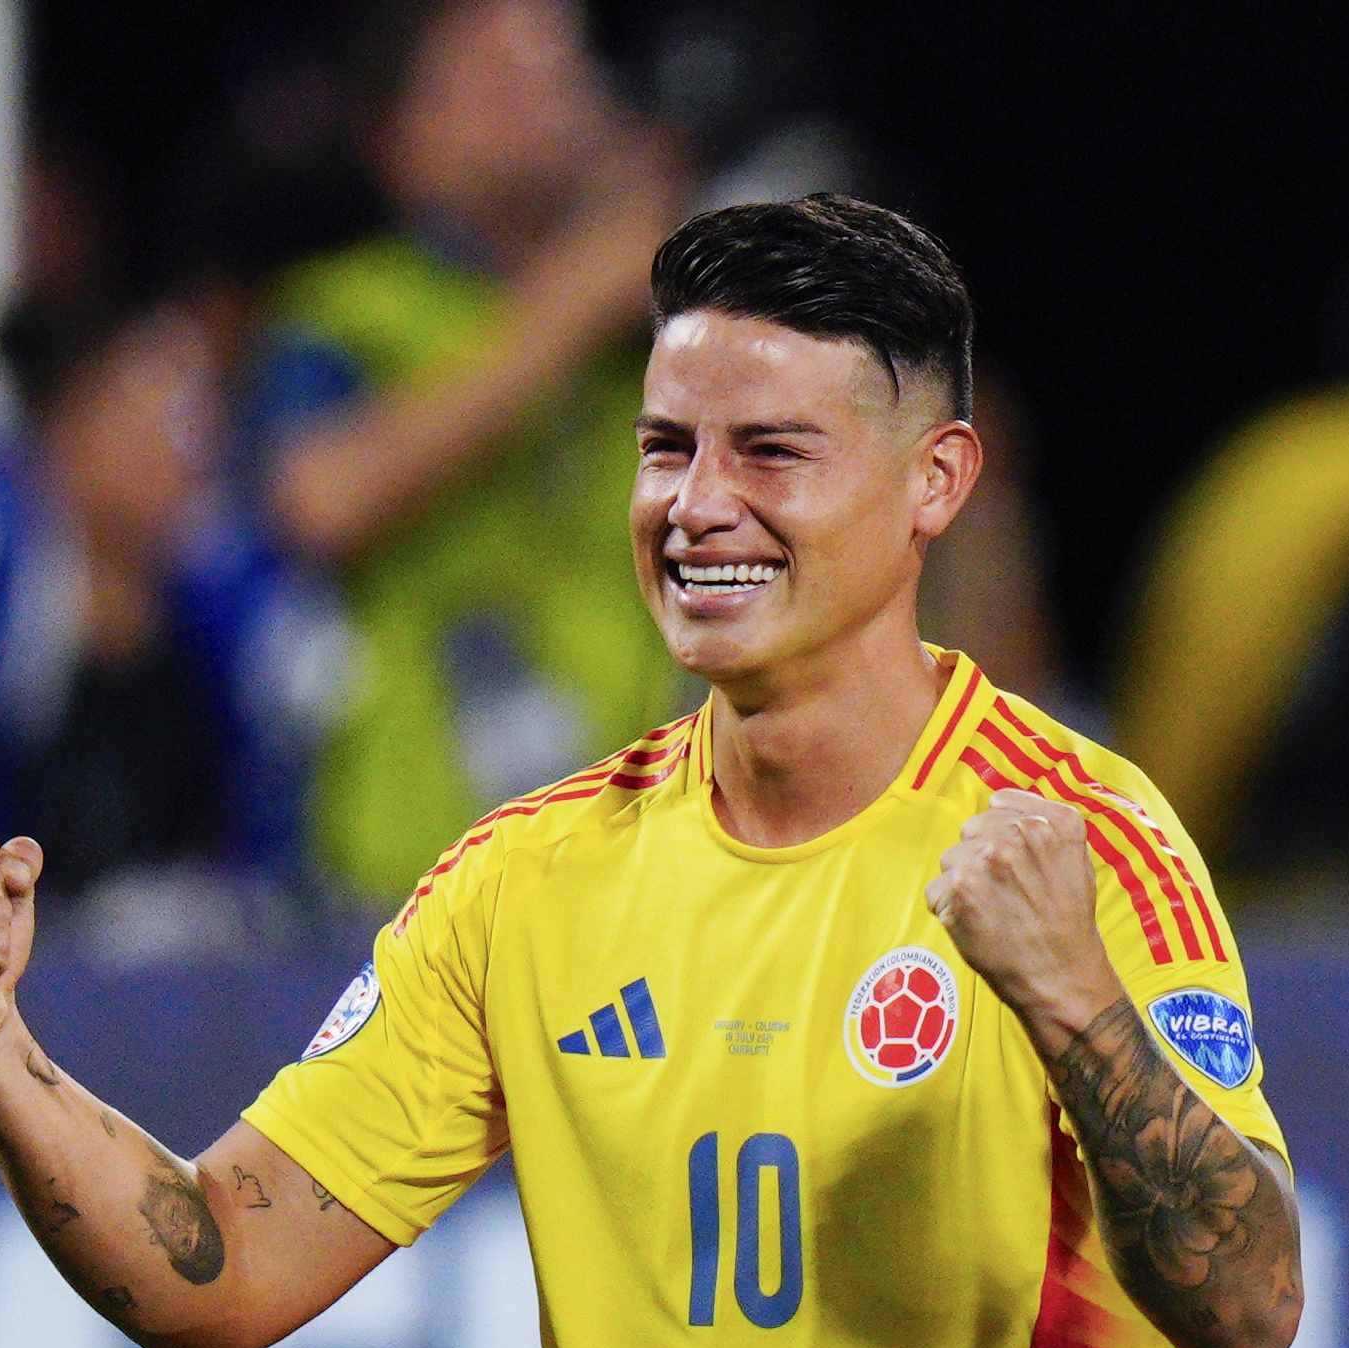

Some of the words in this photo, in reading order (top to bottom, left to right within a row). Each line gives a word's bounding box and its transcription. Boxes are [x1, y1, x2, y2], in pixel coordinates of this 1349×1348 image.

[886, 952, 938, 972] COLOMBIANA
[936, 967, 947, 980] DE
[1170, 1014, 1244, 1040] VIBRA
[689, 1131, 803, 1329] 10
